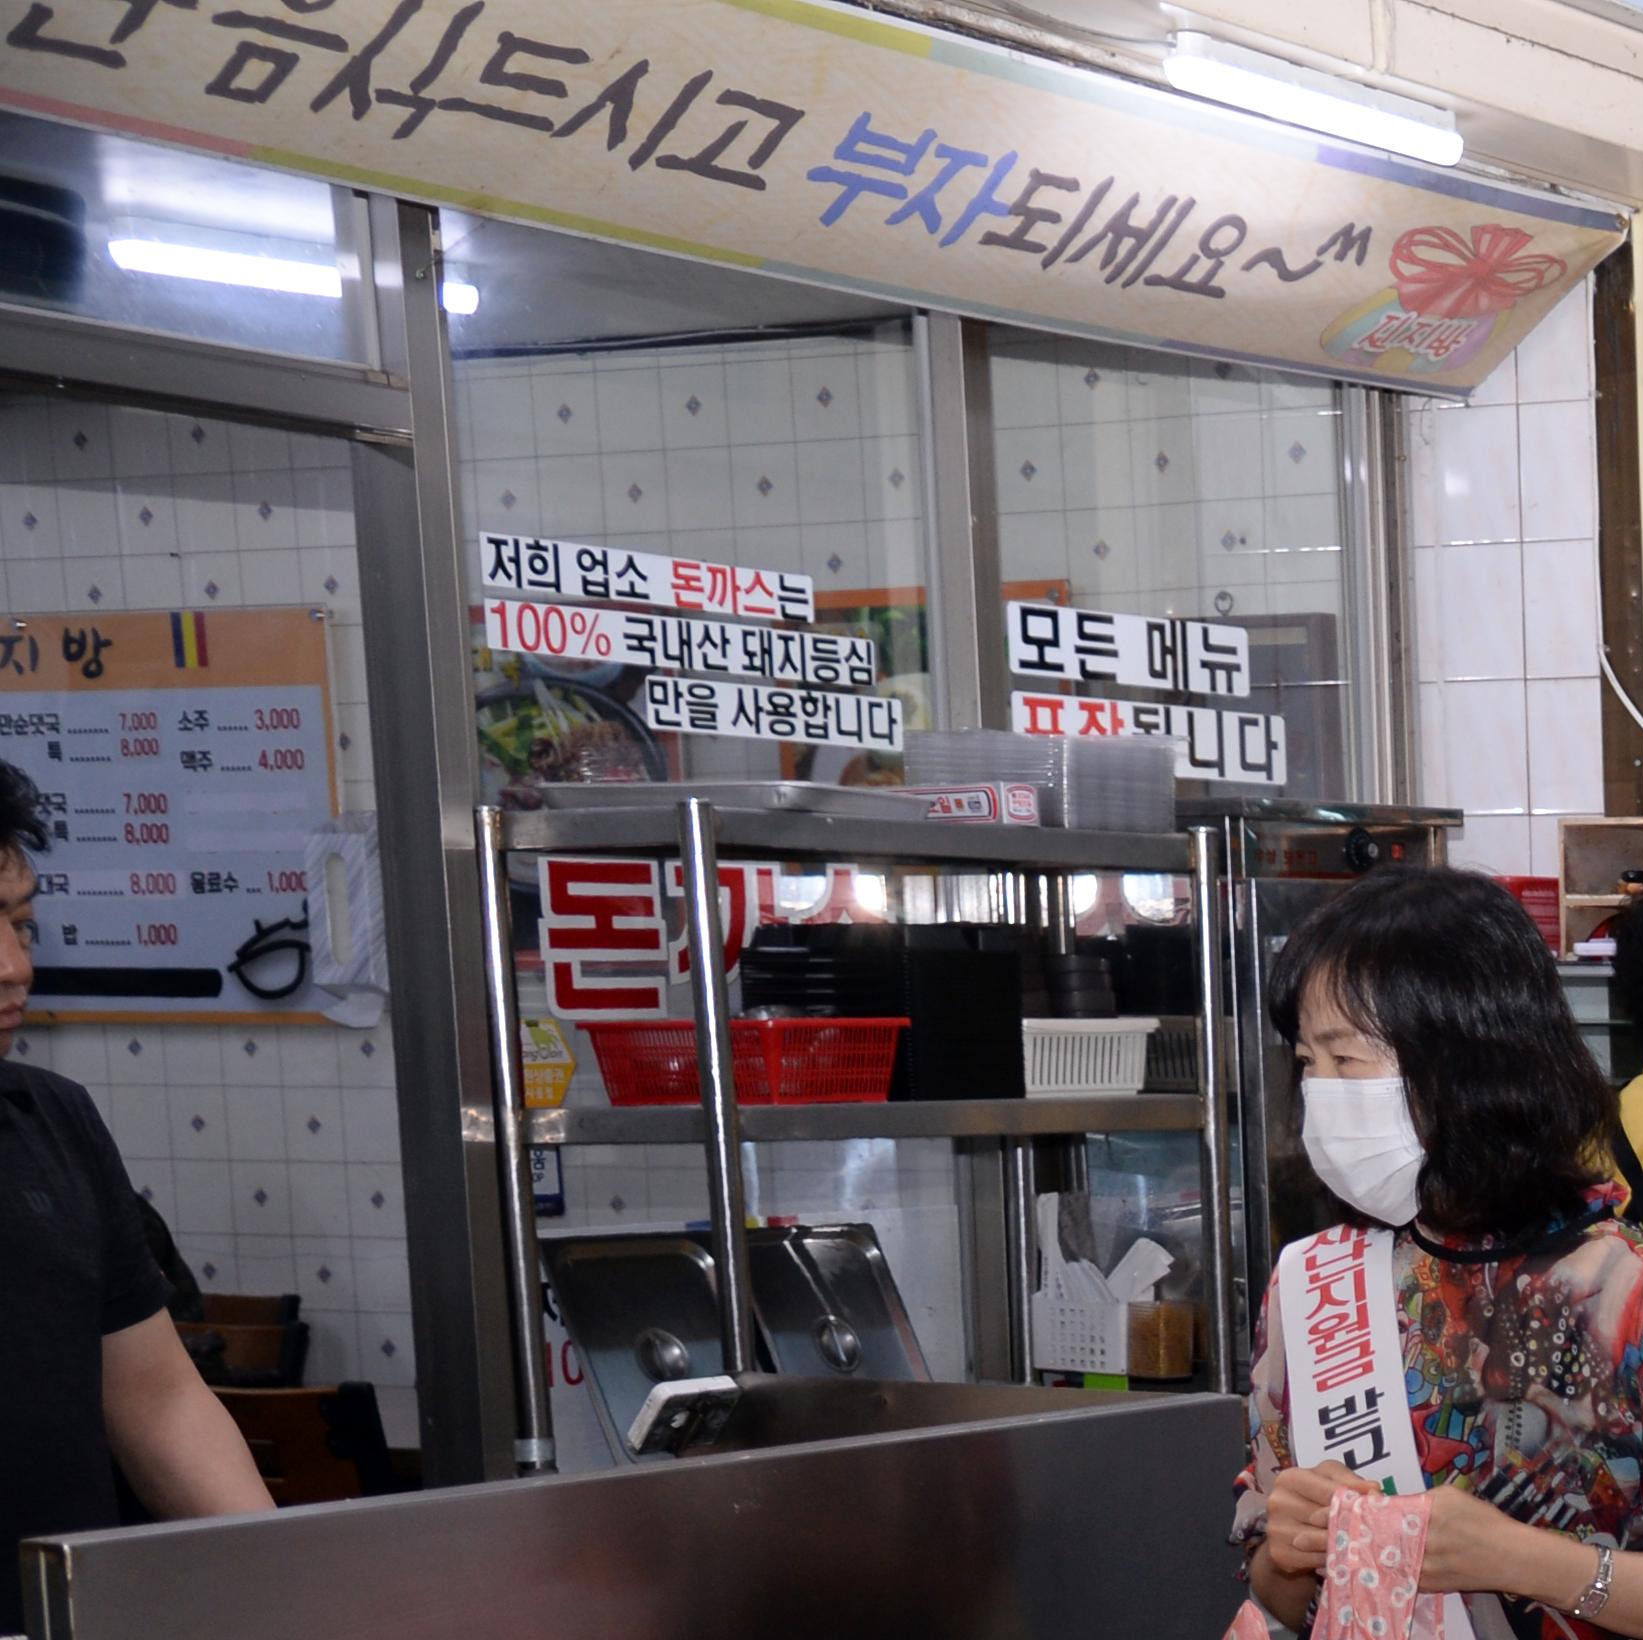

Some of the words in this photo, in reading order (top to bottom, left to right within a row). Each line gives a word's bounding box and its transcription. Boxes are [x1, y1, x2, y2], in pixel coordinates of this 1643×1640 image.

[487, 537, 562, 594] 저희
[575, 547, 650, 600] 업소
[670, 558, 811, 623] 돈까스는
[490, 600, 612, 657] 100%
[622, 615, 732, 674] 국내산
[741, 627, 875, 687] 돼지등심
[1019, 606, 1119, 681] 모든
[1146, 618, 1241, 693] 메뉴
[118, 711, 158, 732] 7,000
[177, 709, 210, 732] 소주
[254, 708, 301, 730] 3,000
[647, 679, 719, 730] 만을
[731, 687, 899, 746] 사용합니다
[120, 736, 160, 757] 8,000
[258, 749, 305, 771] 4,000
[123, 793, 168, 814] 7,000
[124, 822, 170, 844] 8,000
[129, 872, 177, 895] 8,000
[136, 924, 178, 945] 1,000
